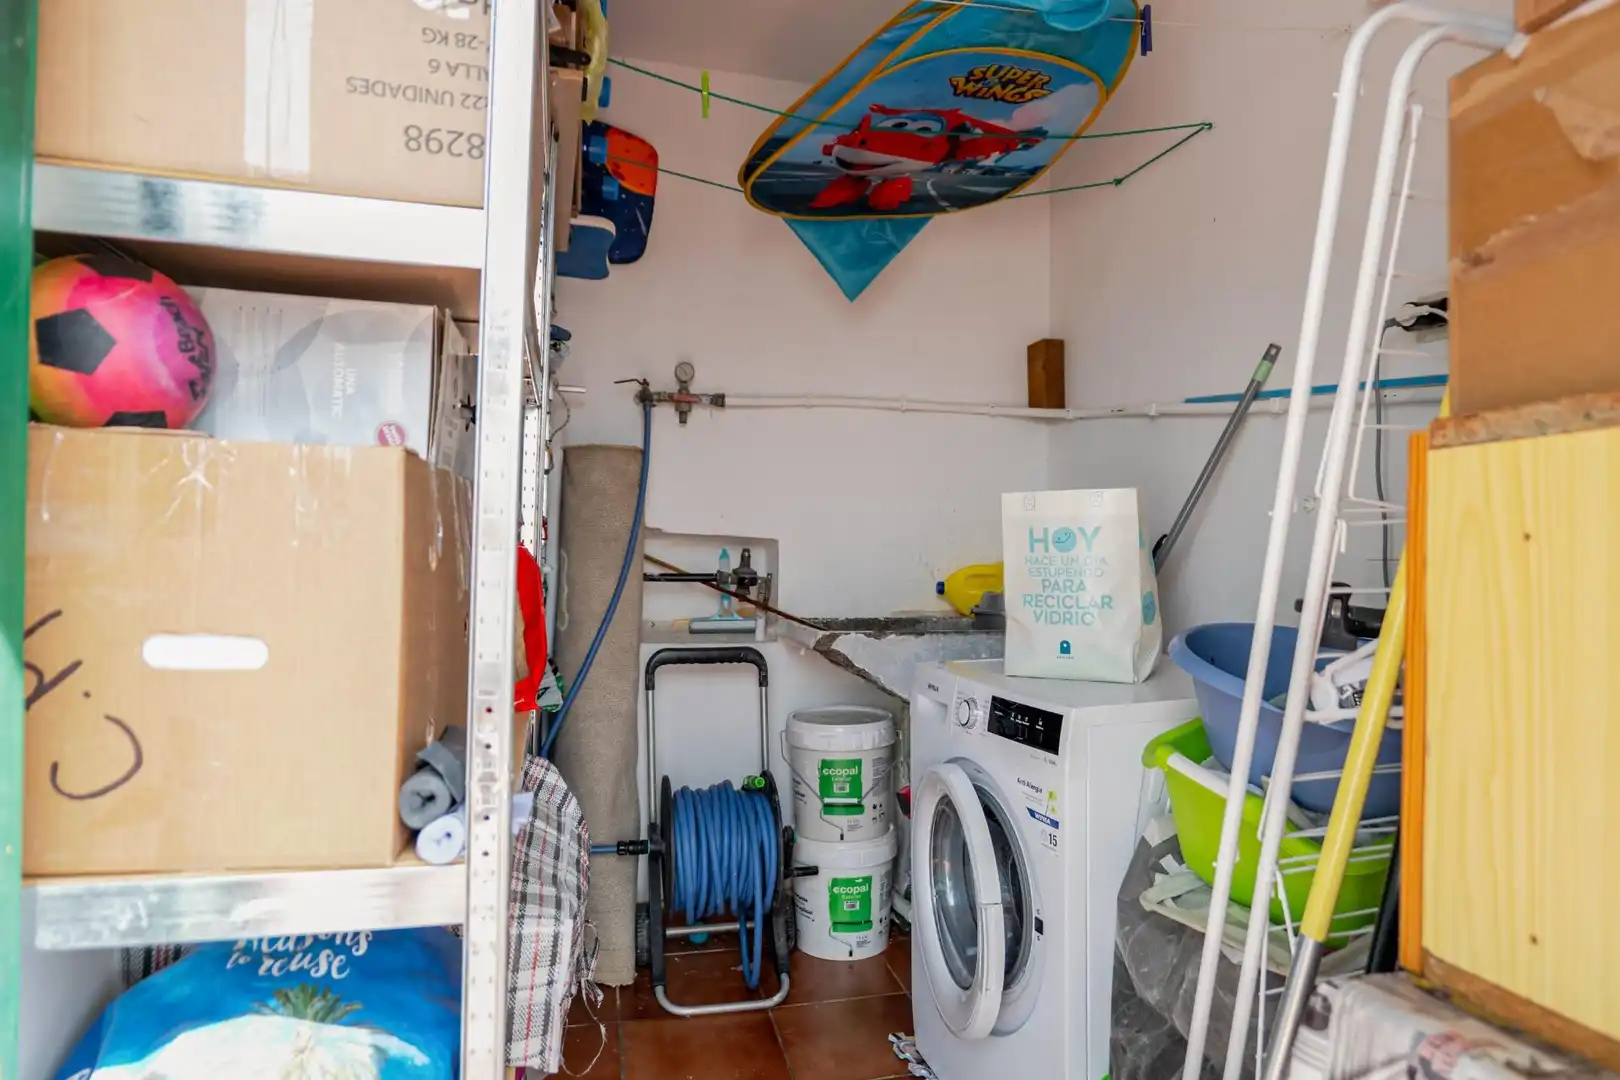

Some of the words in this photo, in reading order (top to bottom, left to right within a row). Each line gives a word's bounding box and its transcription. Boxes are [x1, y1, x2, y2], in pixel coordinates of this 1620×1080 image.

[421, 26, 449, 46] KG
[968, 63, 1051, 89] SUPER
[345, 75, 455, 107] UNIDADES
[949, 76, 1055, 104] WINGS
[1028, 525, 1103, 553] HOY
[1024, 556, 1059, 567] HACE
[1061, 556, 1080, 567] UN
[1041, 578, 1087, 594] PARA
[1022, 593, 1114, 610] RECICLAR
[1032, 609, 1096, 627] VIDRIO
[822, 765, 859, 777] ecopal
[1048, 833, 1058, 847] 15
[832, 882, 869, 895] ecopal
[257, 948, 351, 980] reuse
